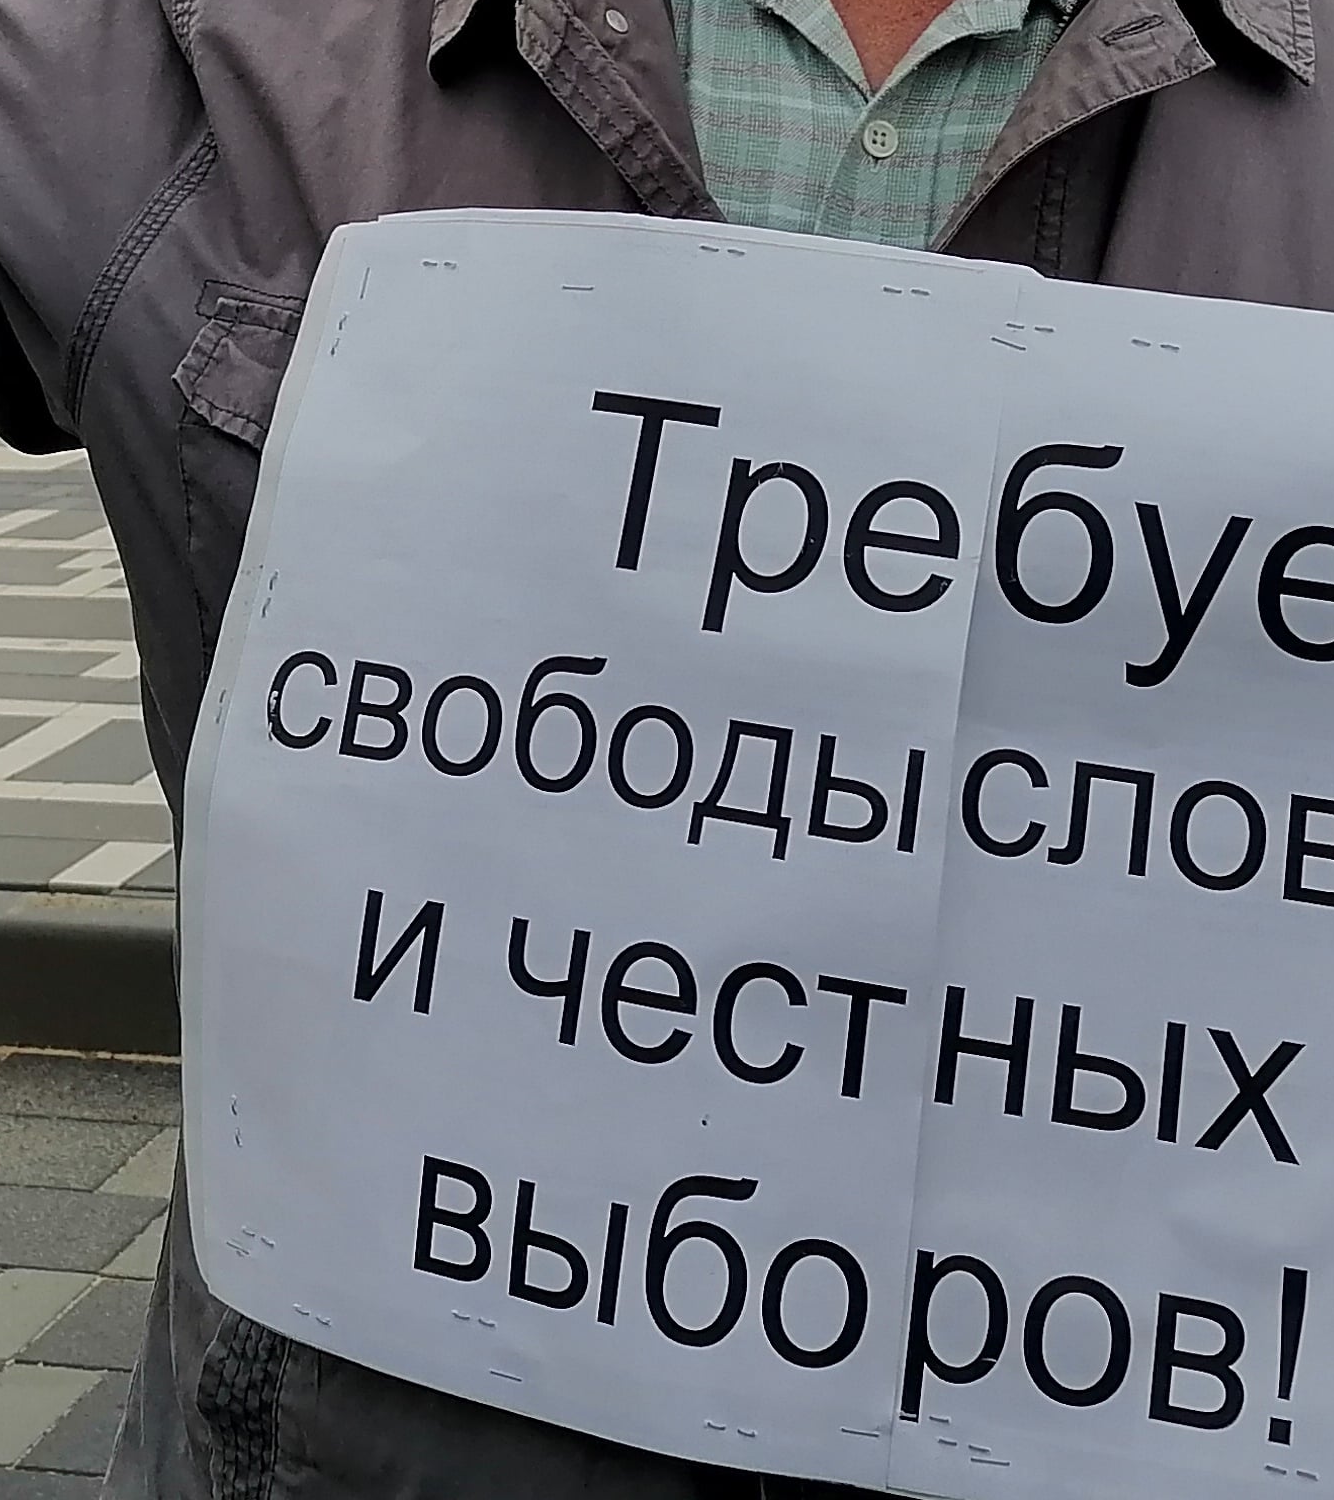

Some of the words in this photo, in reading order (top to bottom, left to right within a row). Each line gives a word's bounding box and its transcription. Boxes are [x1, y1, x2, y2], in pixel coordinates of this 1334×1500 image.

[265, 648, 927, 862] свободы
[351, 888, 446, 1017] и
[506, 915, 1308, 1167] честных
[411, 1153, 1311, 1447] выборов!
